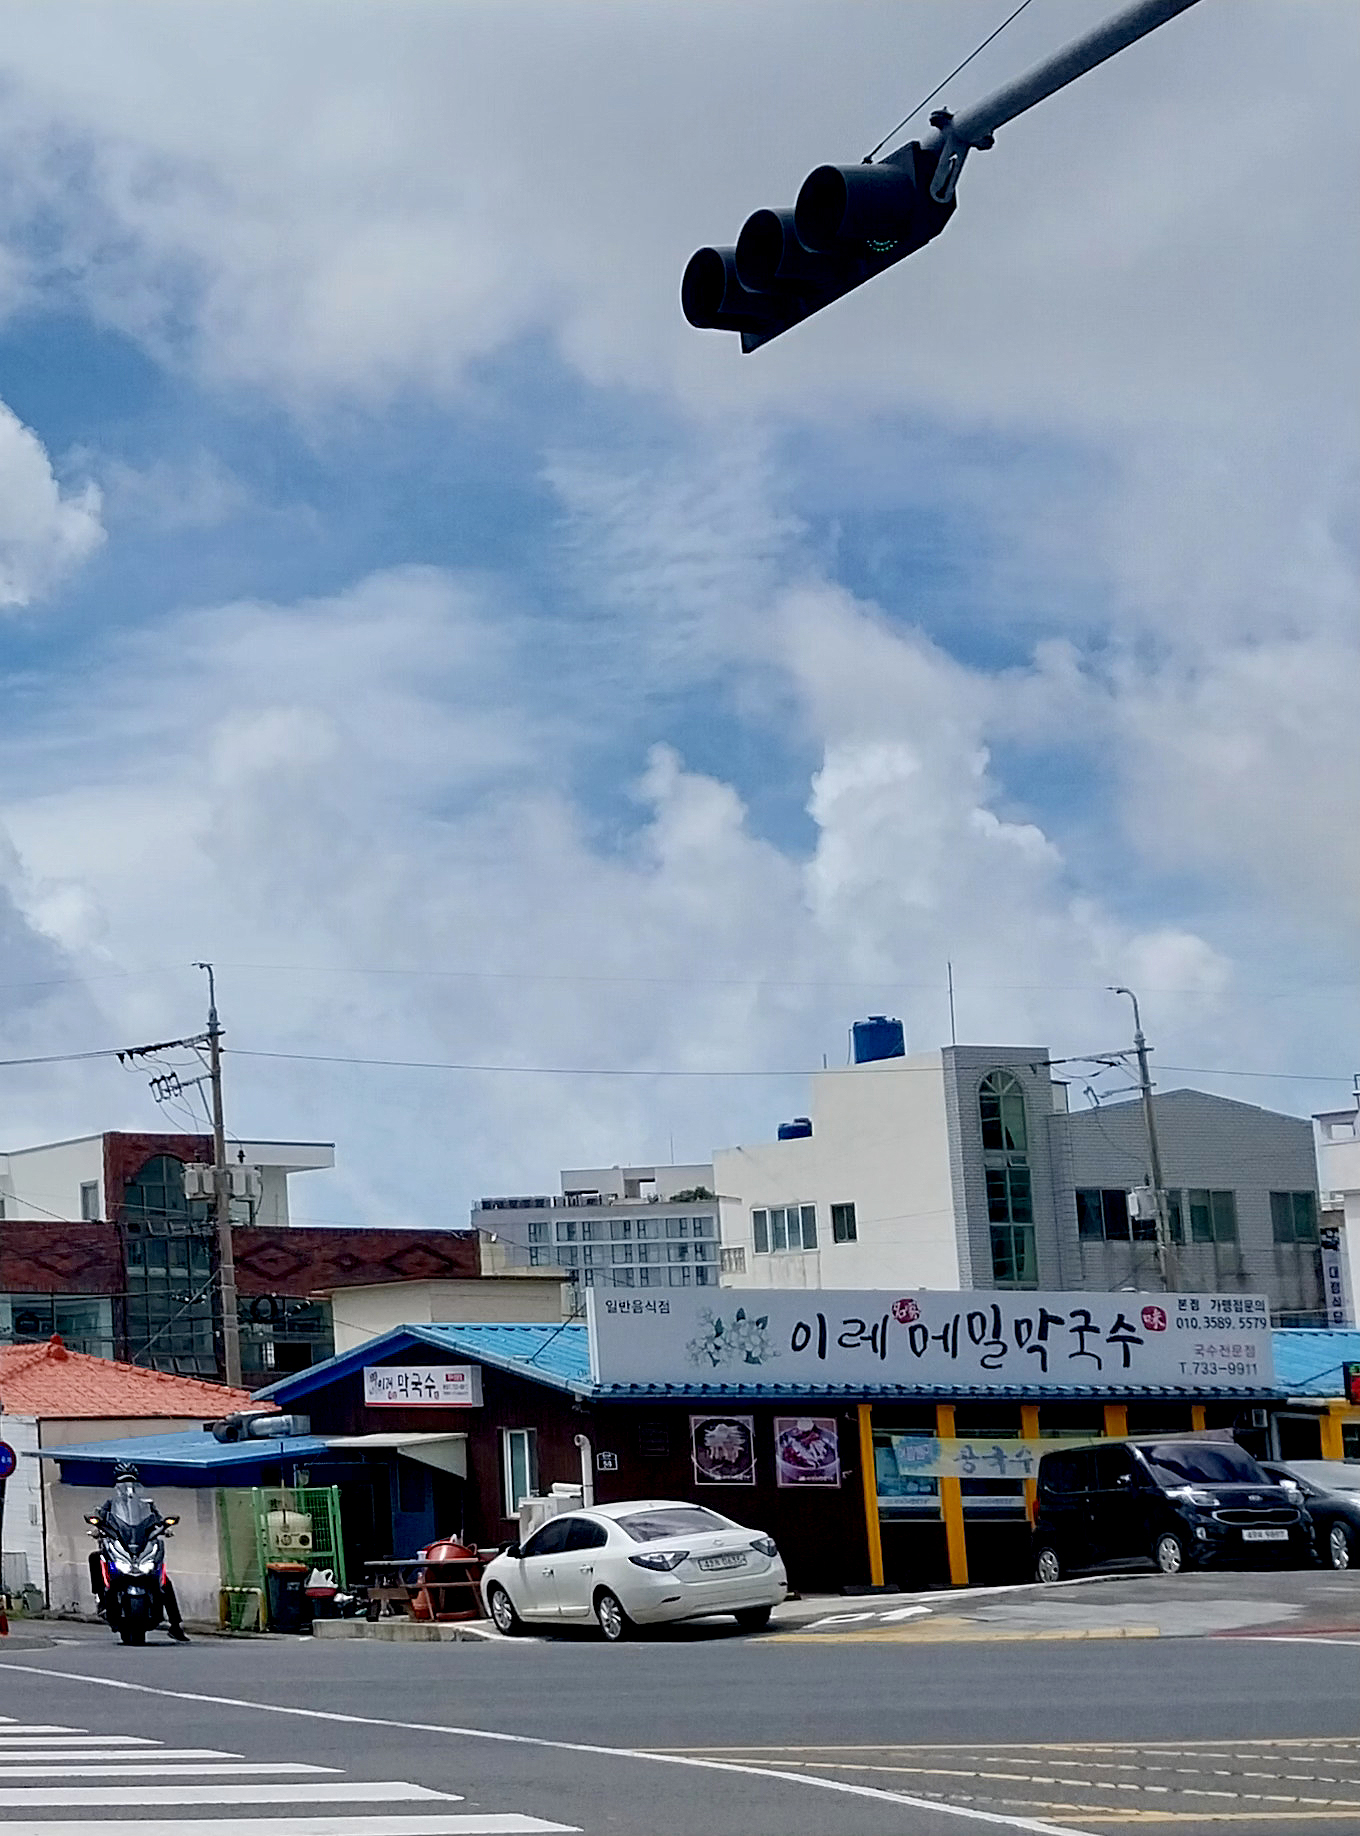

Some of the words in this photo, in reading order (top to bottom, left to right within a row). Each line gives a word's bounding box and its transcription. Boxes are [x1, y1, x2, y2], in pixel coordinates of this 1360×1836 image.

[605, 1299, 670, 1314] 일반음식점
[1176, 1316, 1267, 1330] 010.3589.5579
[1178, 1361, 1258, 1376] T.733-9911
